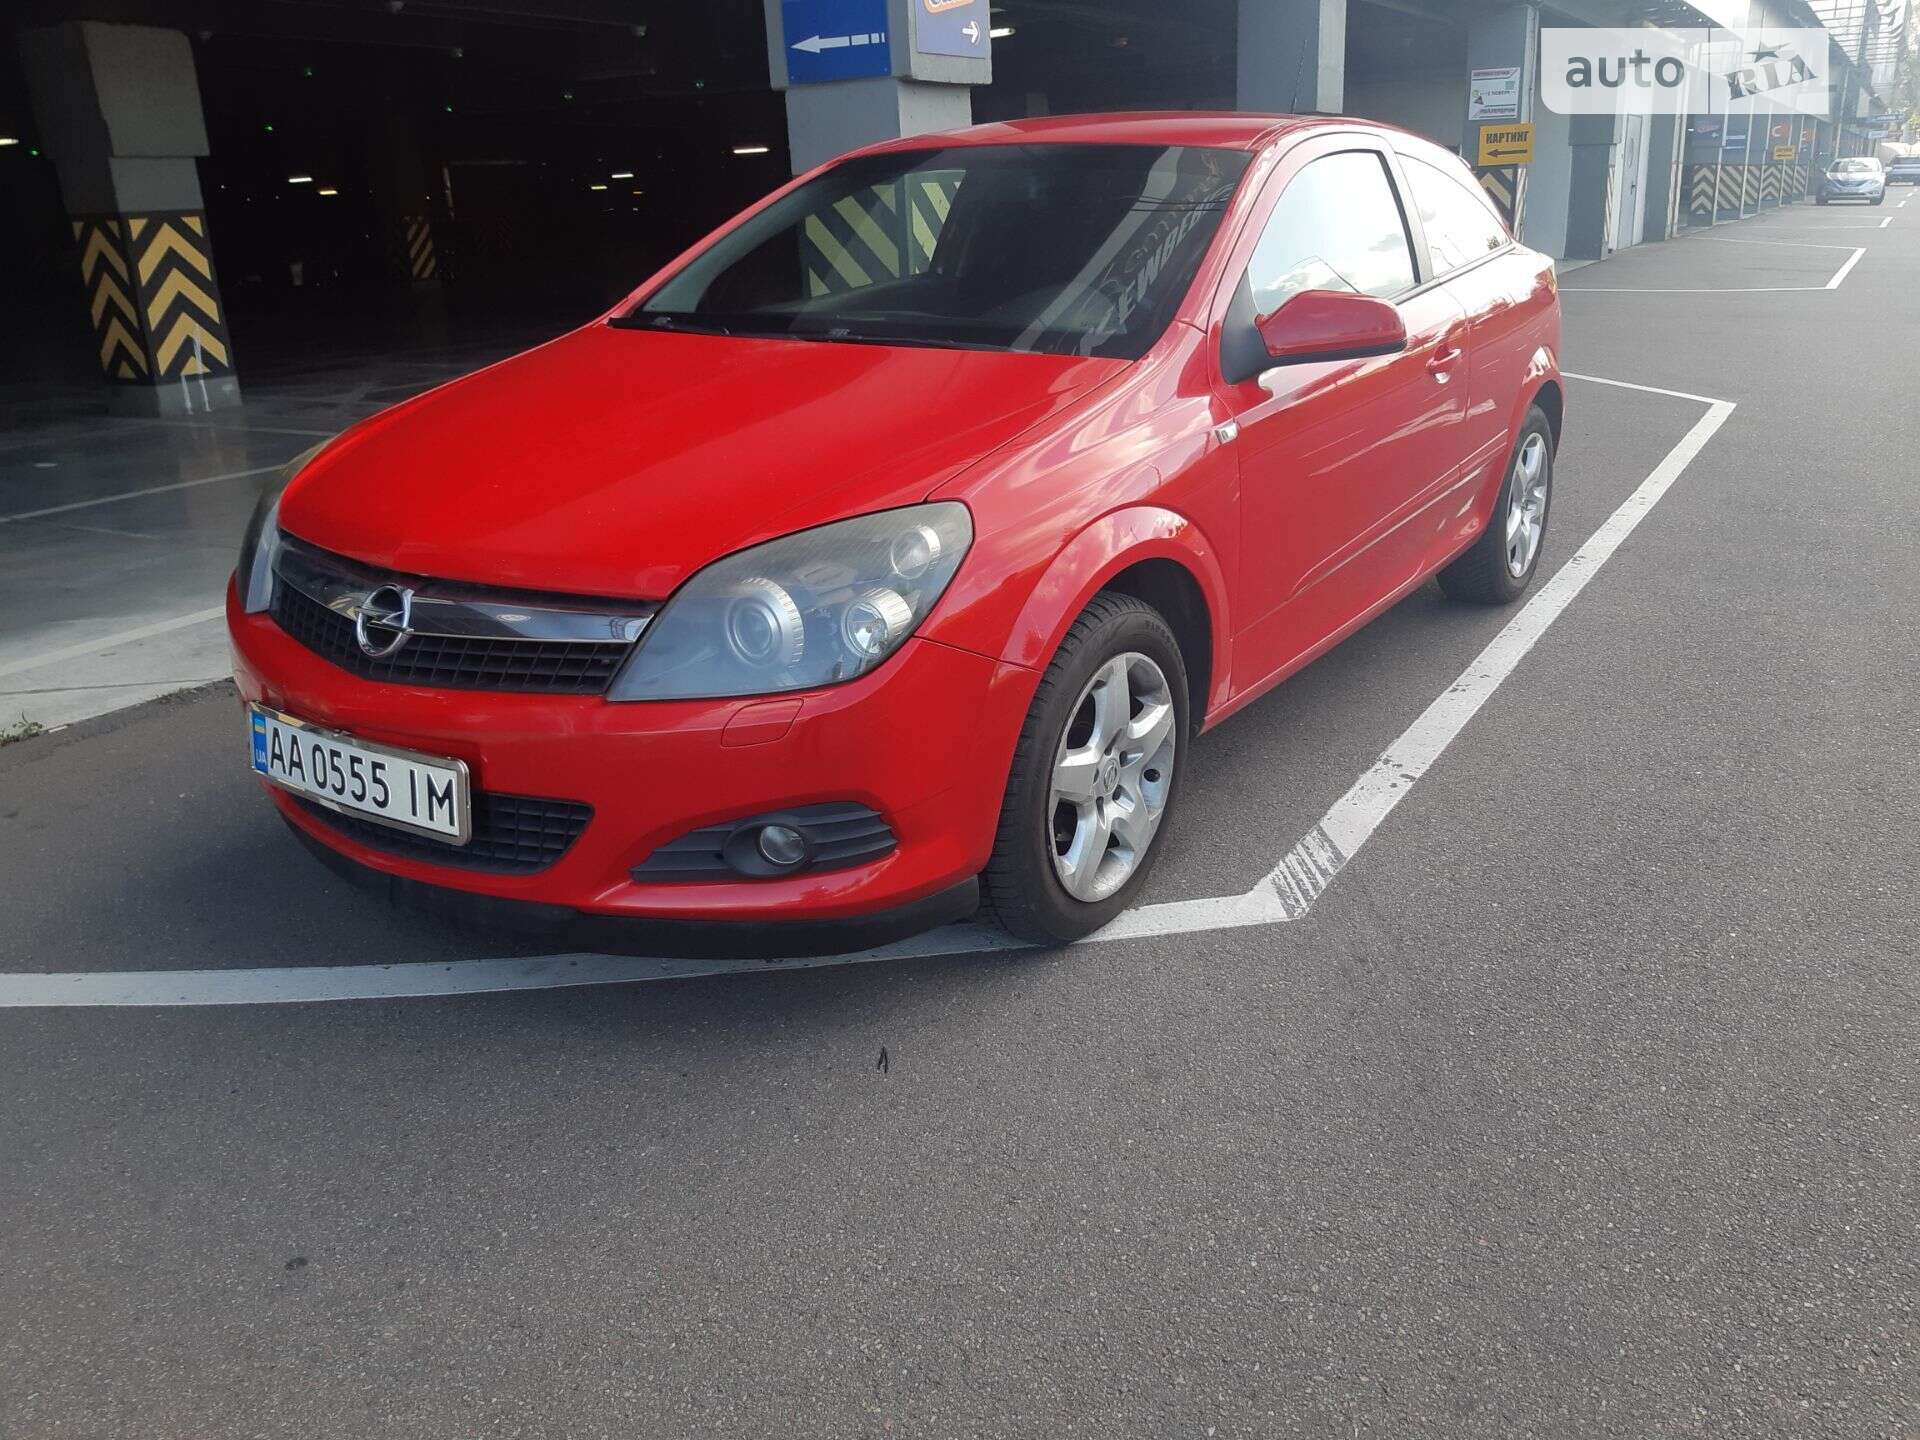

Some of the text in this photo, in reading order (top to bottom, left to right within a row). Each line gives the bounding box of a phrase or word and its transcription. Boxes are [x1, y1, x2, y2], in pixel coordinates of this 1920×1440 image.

[1486, 131, 1529, 144] КАРТИНГ
[255, 748, 267, 765] UA
[409, 767, 457, 827] IM
